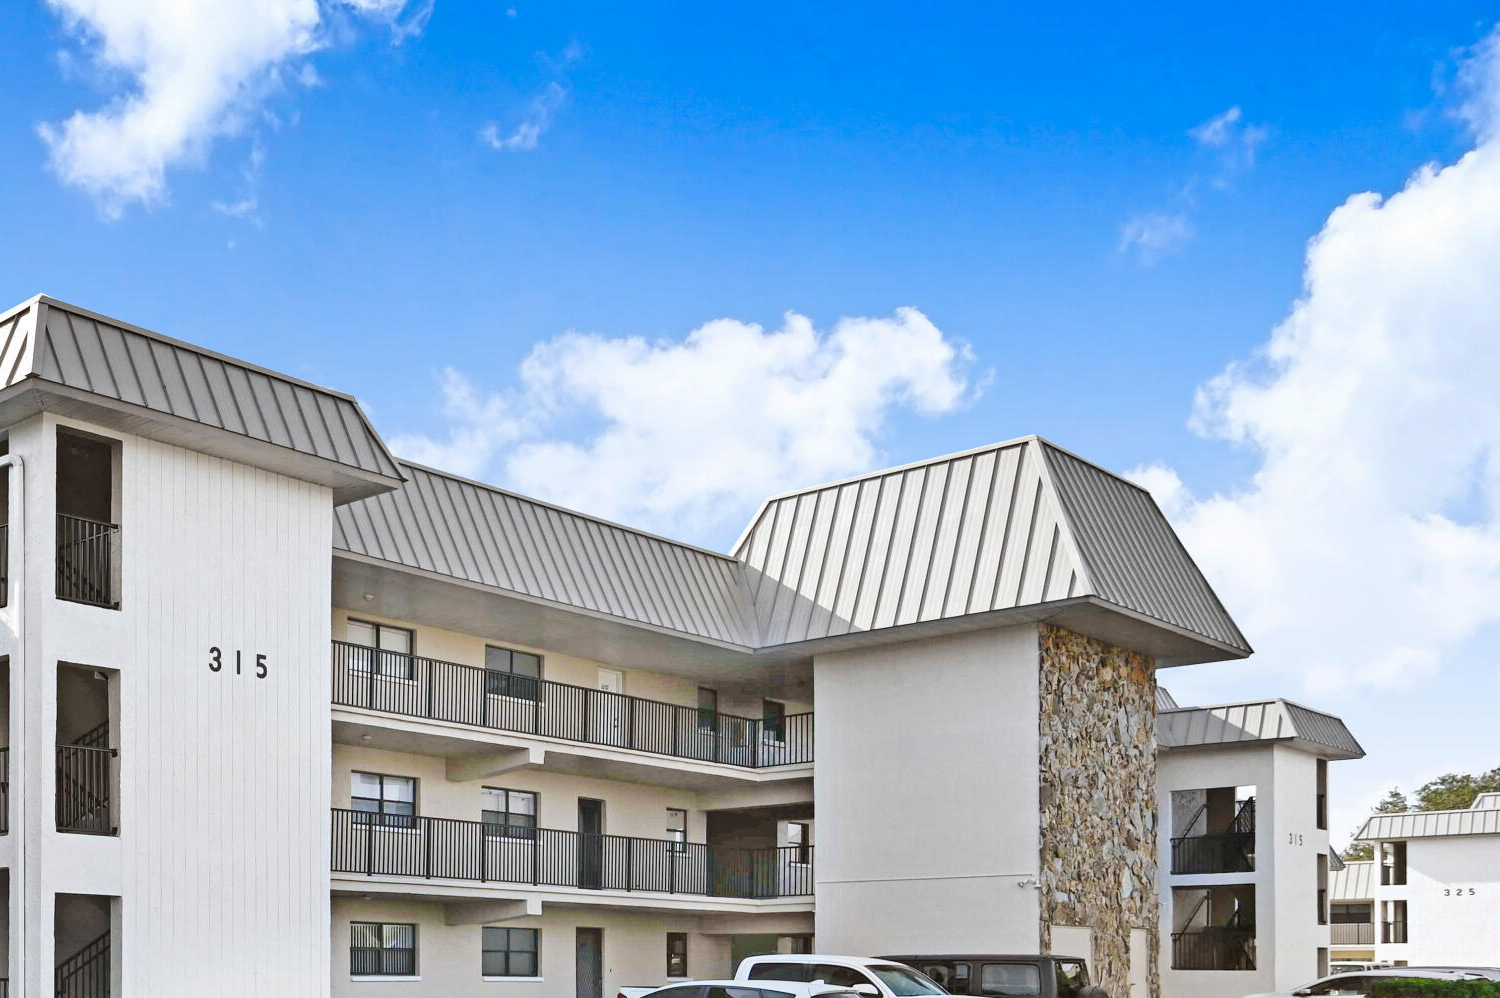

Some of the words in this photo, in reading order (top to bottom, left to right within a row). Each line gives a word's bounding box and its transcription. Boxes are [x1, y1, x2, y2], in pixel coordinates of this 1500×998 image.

[208, 646, 268, 679] 315
[1288, 832, 1303, 847] 315
[1443, 888, 1476, 897] 325
